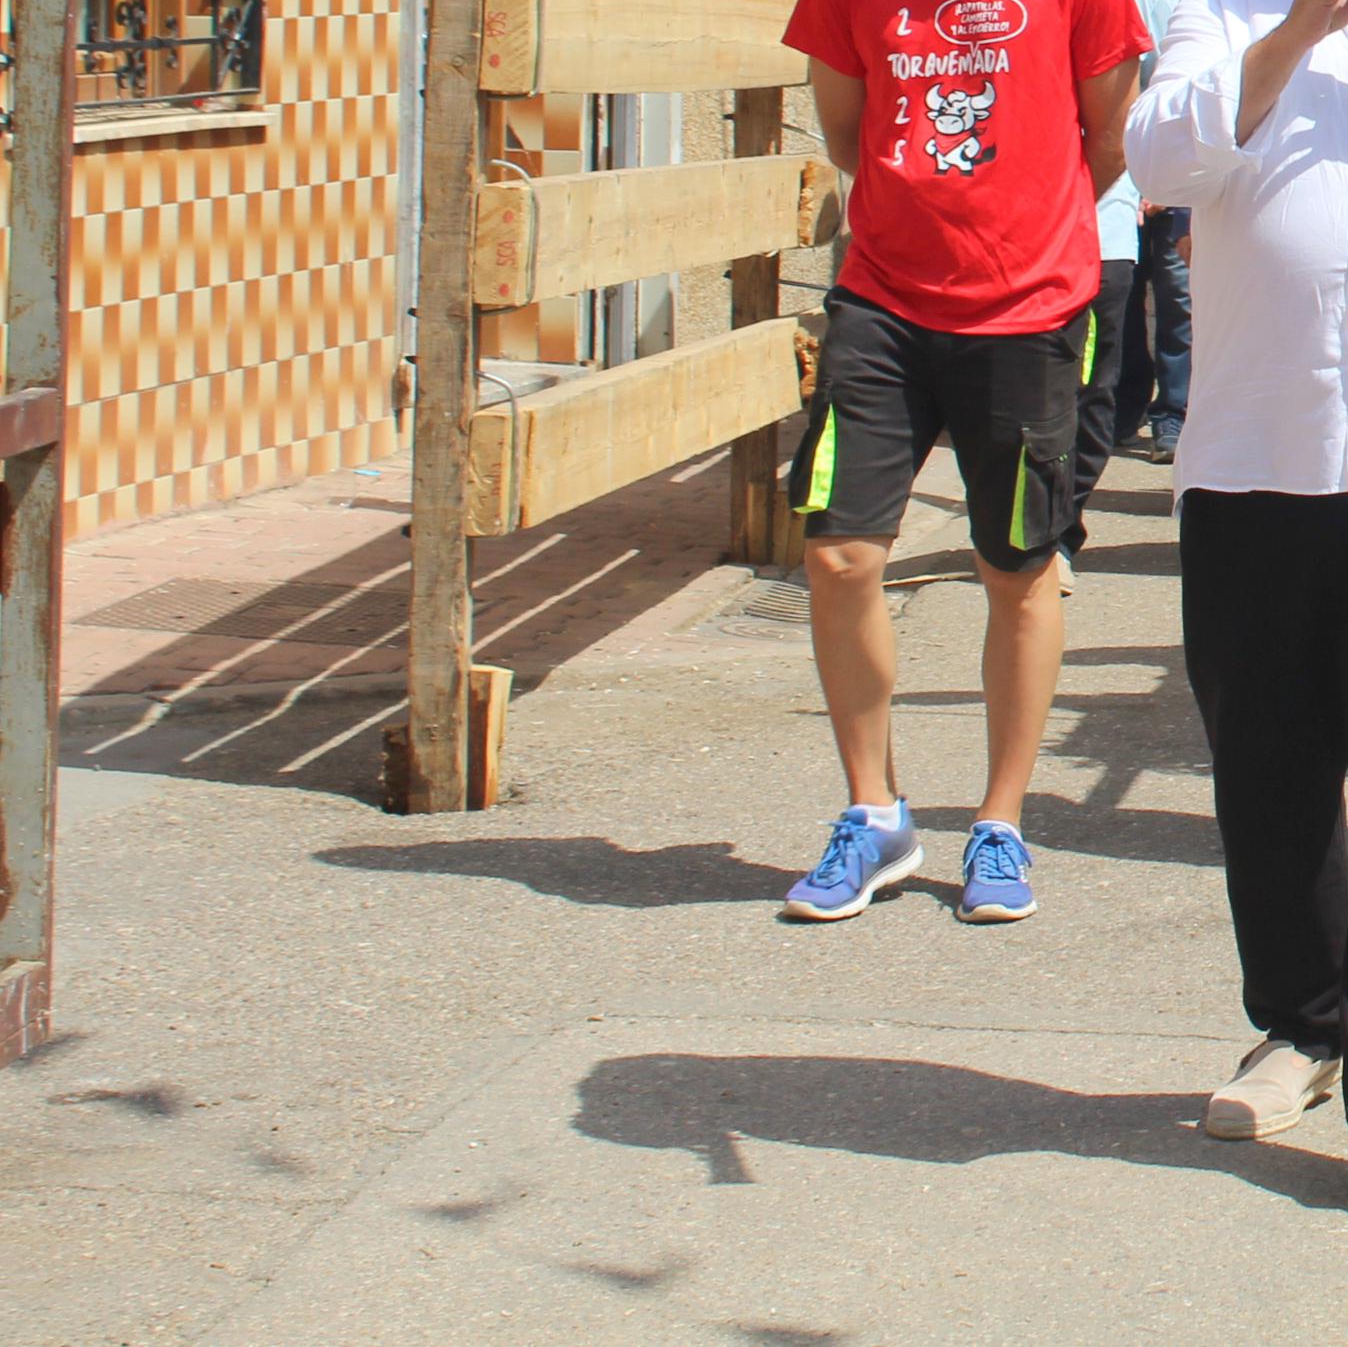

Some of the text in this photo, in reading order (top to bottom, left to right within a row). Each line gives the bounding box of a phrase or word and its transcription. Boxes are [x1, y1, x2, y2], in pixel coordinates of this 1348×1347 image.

[896, 7, 912, 36] 2
[957, 24, 968, 35] AL
[960, 11, 999, 24] CAMISETA
[887, 48, 1009, 80] TORQUEMADA
[894, 95, 911, 124] 2
[892, 139, 907, 166] 5
